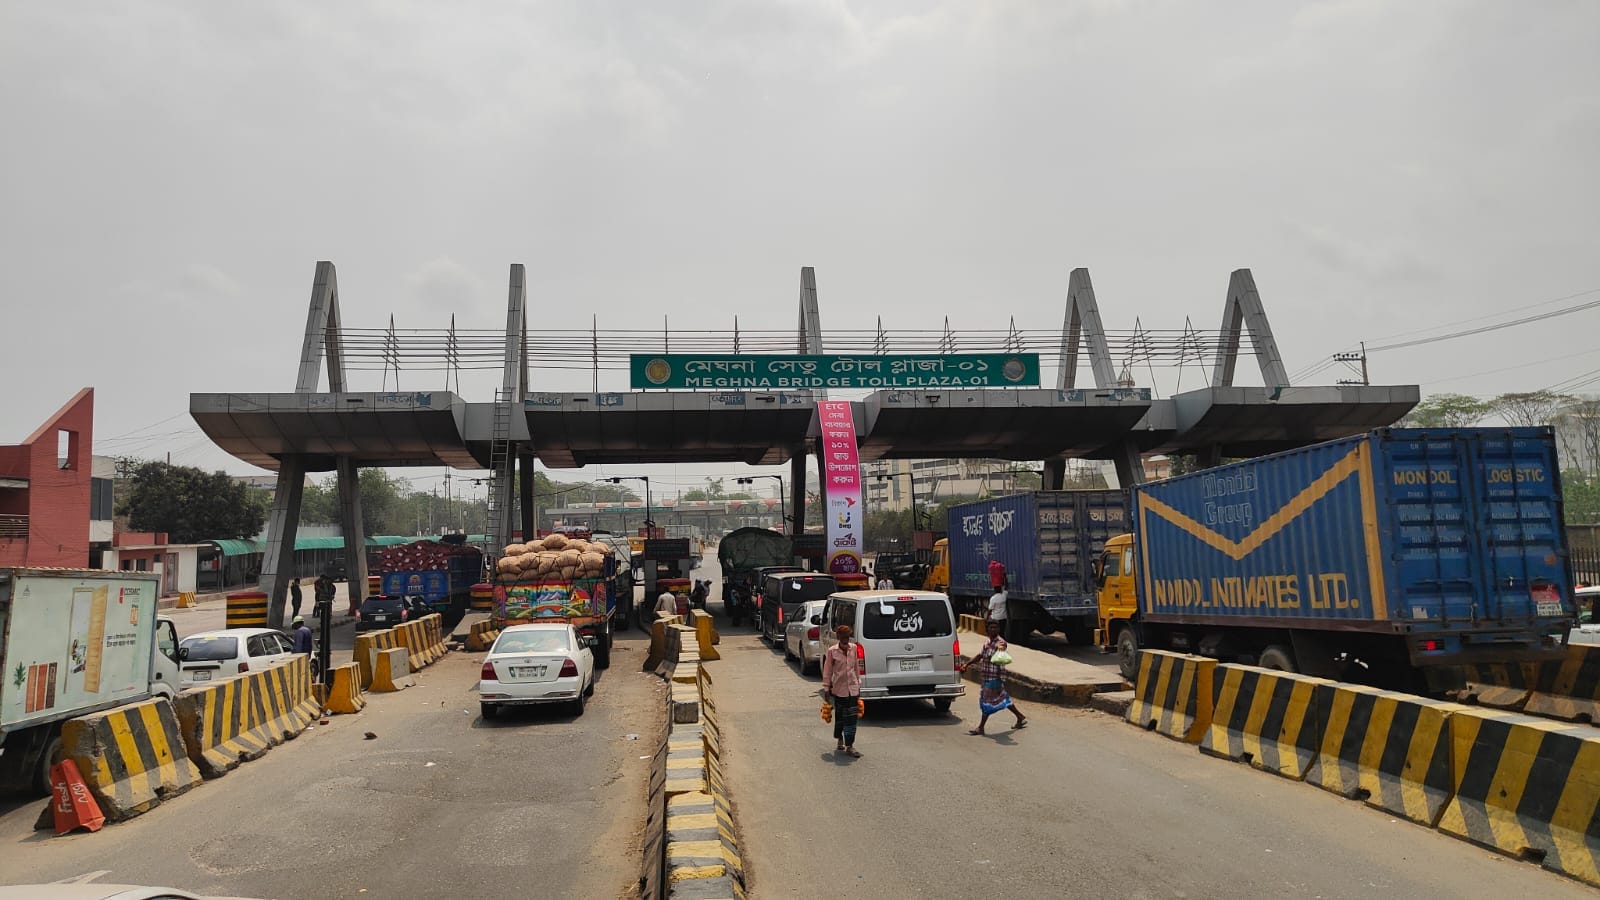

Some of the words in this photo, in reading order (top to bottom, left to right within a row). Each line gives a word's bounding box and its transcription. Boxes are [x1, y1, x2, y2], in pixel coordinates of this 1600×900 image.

[684, 360, 755, 373] মেঘনা
[767, 359, 818, 375] সেতু
[830, 355, 883, 373] টোল
[890, 358, 989, 374] প্লাজা-০১
[685, 377, 772, 387] MEGHNA
[778, 377, 850, 387] BRIDGE
[857, 376, 902, 387] TOLL
[906, 375, 989, 386] PLAZA-01
[1394, 470, 1457, 486] MONDOL
[1308, 573, 1360, 609] LTD.
[54, 781, 73, 812] Fresh
